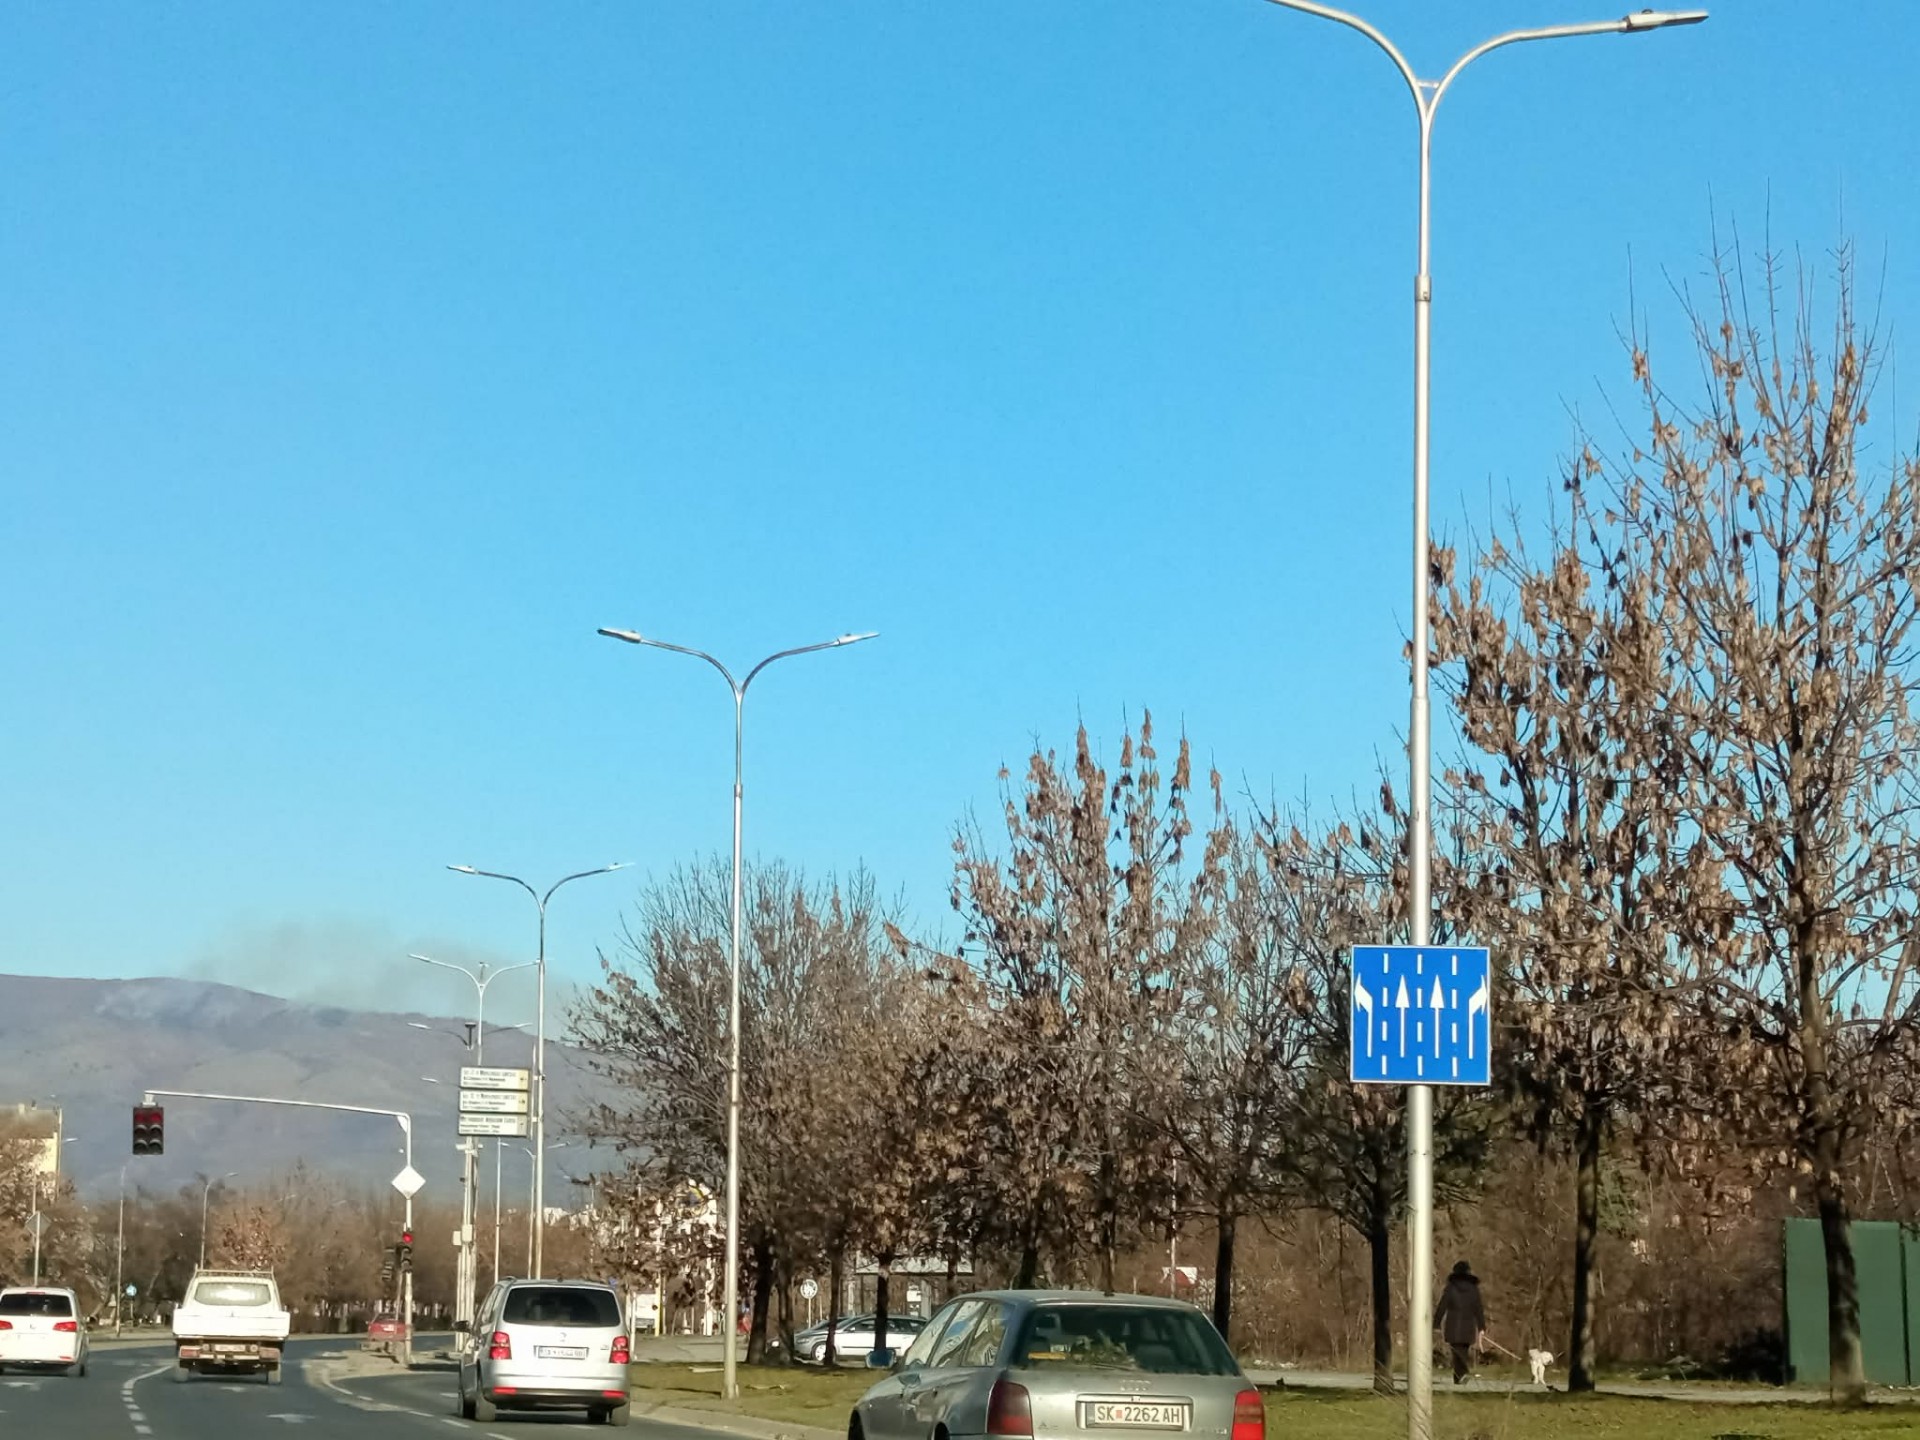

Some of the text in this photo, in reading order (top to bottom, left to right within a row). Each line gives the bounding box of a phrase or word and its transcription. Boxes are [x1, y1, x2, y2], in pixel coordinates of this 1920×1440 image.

[1097, 1406, 1180, 1423] SK 2262 AH
